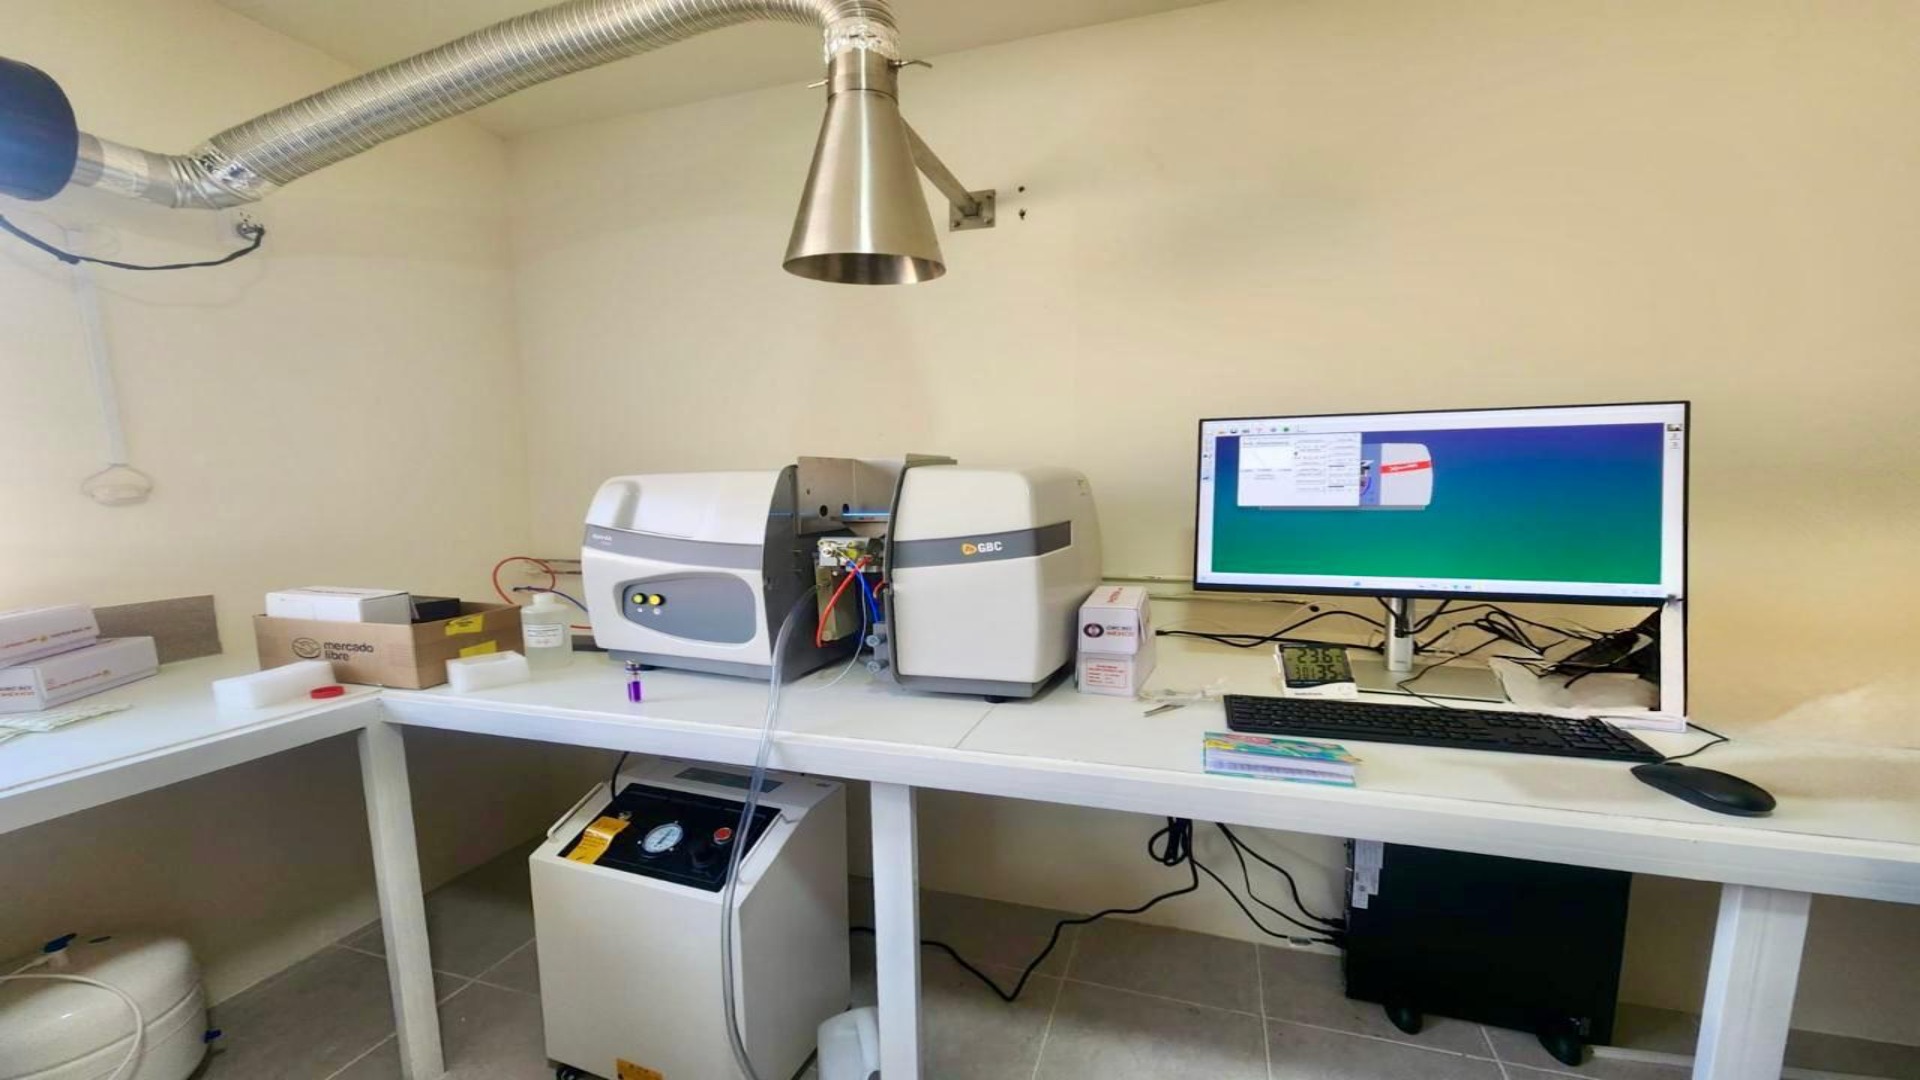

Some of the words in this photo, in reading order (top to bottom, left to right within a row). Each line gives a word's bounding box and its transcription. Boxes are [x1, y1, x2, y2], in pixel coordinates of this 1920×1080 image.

[978, 541, 1002, 553] GBC
[324, 642, 374, 653] mercado
[325, 649, 349, 661] libre
